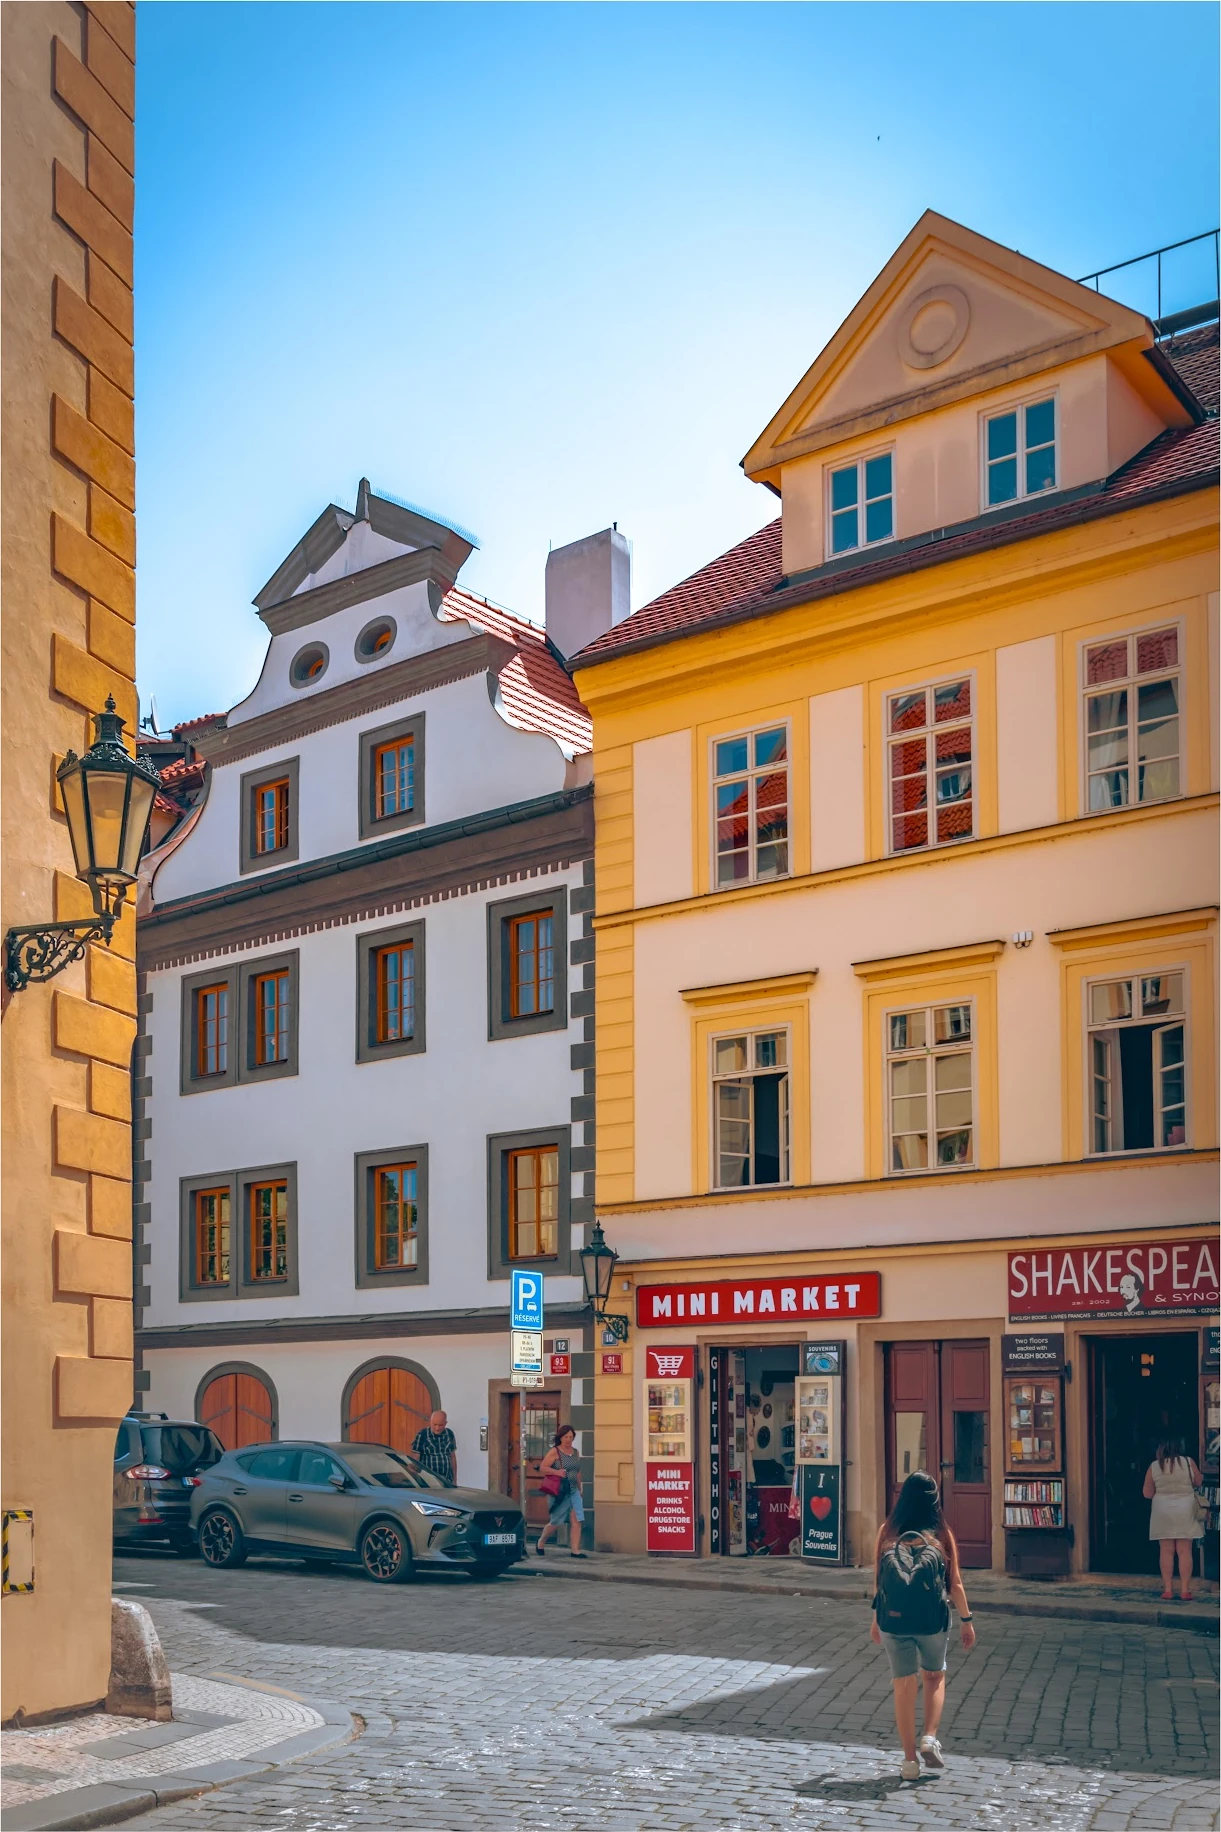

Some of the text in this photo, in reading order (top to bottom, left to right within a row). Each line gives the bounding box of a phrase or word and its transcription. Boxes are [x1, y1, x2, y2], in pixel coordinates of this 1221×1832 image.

[1010, 1244, 1219, 1298] SHAKESPEA
[518, 1278, 536, 1310] P
[1154, 1291, 1220, 1303] & SYNO
[652, 1284, 861, 1317] MINI MARKET
[514, 1314, 540, 1323] RÉSERVÉ
[605, 1333, 613, 1343] 10
[557, 1341, 566, 1351] 12
[607, 1356, 616, 1365] 91
[1008, 1352, 1034, 1360] ENGLISH
[555, 1357, 564, 1366] 93
[710, 1356, 719, 1543] GIFT SHOP
[657, 1469, 681, 1479] MINI
[648, 1480, 691, 1491] MARKET
[817, 1473, 826, 1489] I
[656, 1497, 683, 1505] DRINKS
[653, 1506, 686, 1514] ALCOHOL
[649, 1516, 691, 1524] DRUGSTORE
[657, 1525, 686, 1534] SNACKS
[808, 1528, 834, 1540] Prague
[804, 1540, 837, 1551] Souvenirs
